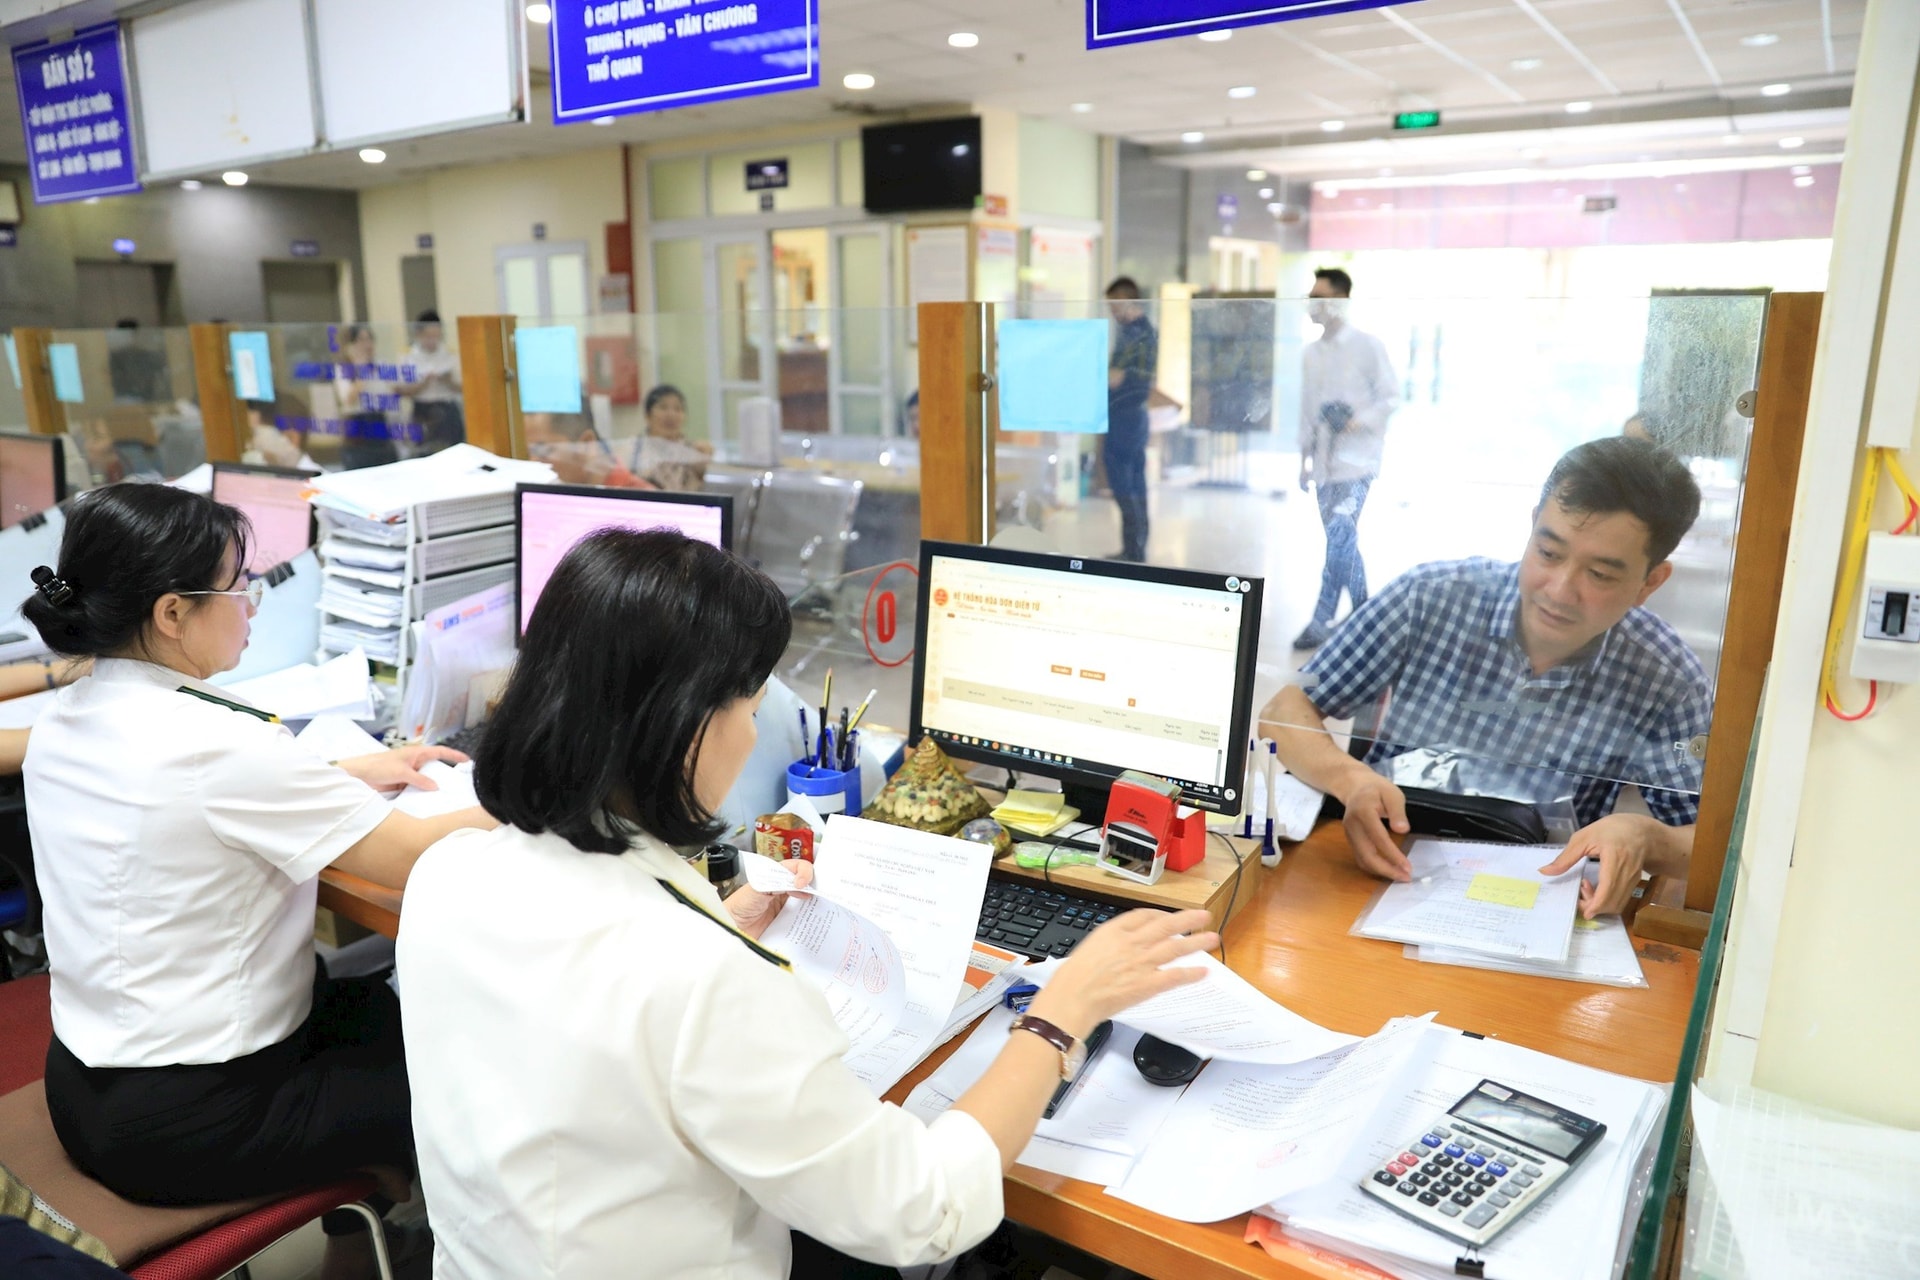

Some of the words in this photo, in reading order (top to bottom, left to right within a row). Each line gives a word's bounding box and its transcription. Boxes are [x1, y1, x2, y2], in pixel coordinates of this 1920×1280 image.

[585, 31, 624, 55] TRUNG
[624, 22, 666, 48] PHỤNG
[675, 13, 701, 38] VĂN
[703, 3, 758, 32] CHƯƠNG
[84, 50, 95, 79] 2
[610, 55, 643, 80] QUAN
[1459, 1164, 1468, 1172] 8
[1400, 1182, 1414, 1192] 00
[1447, 1174, 1456, 1182] 5
[1469, 1183, 1478, 1191] 6
